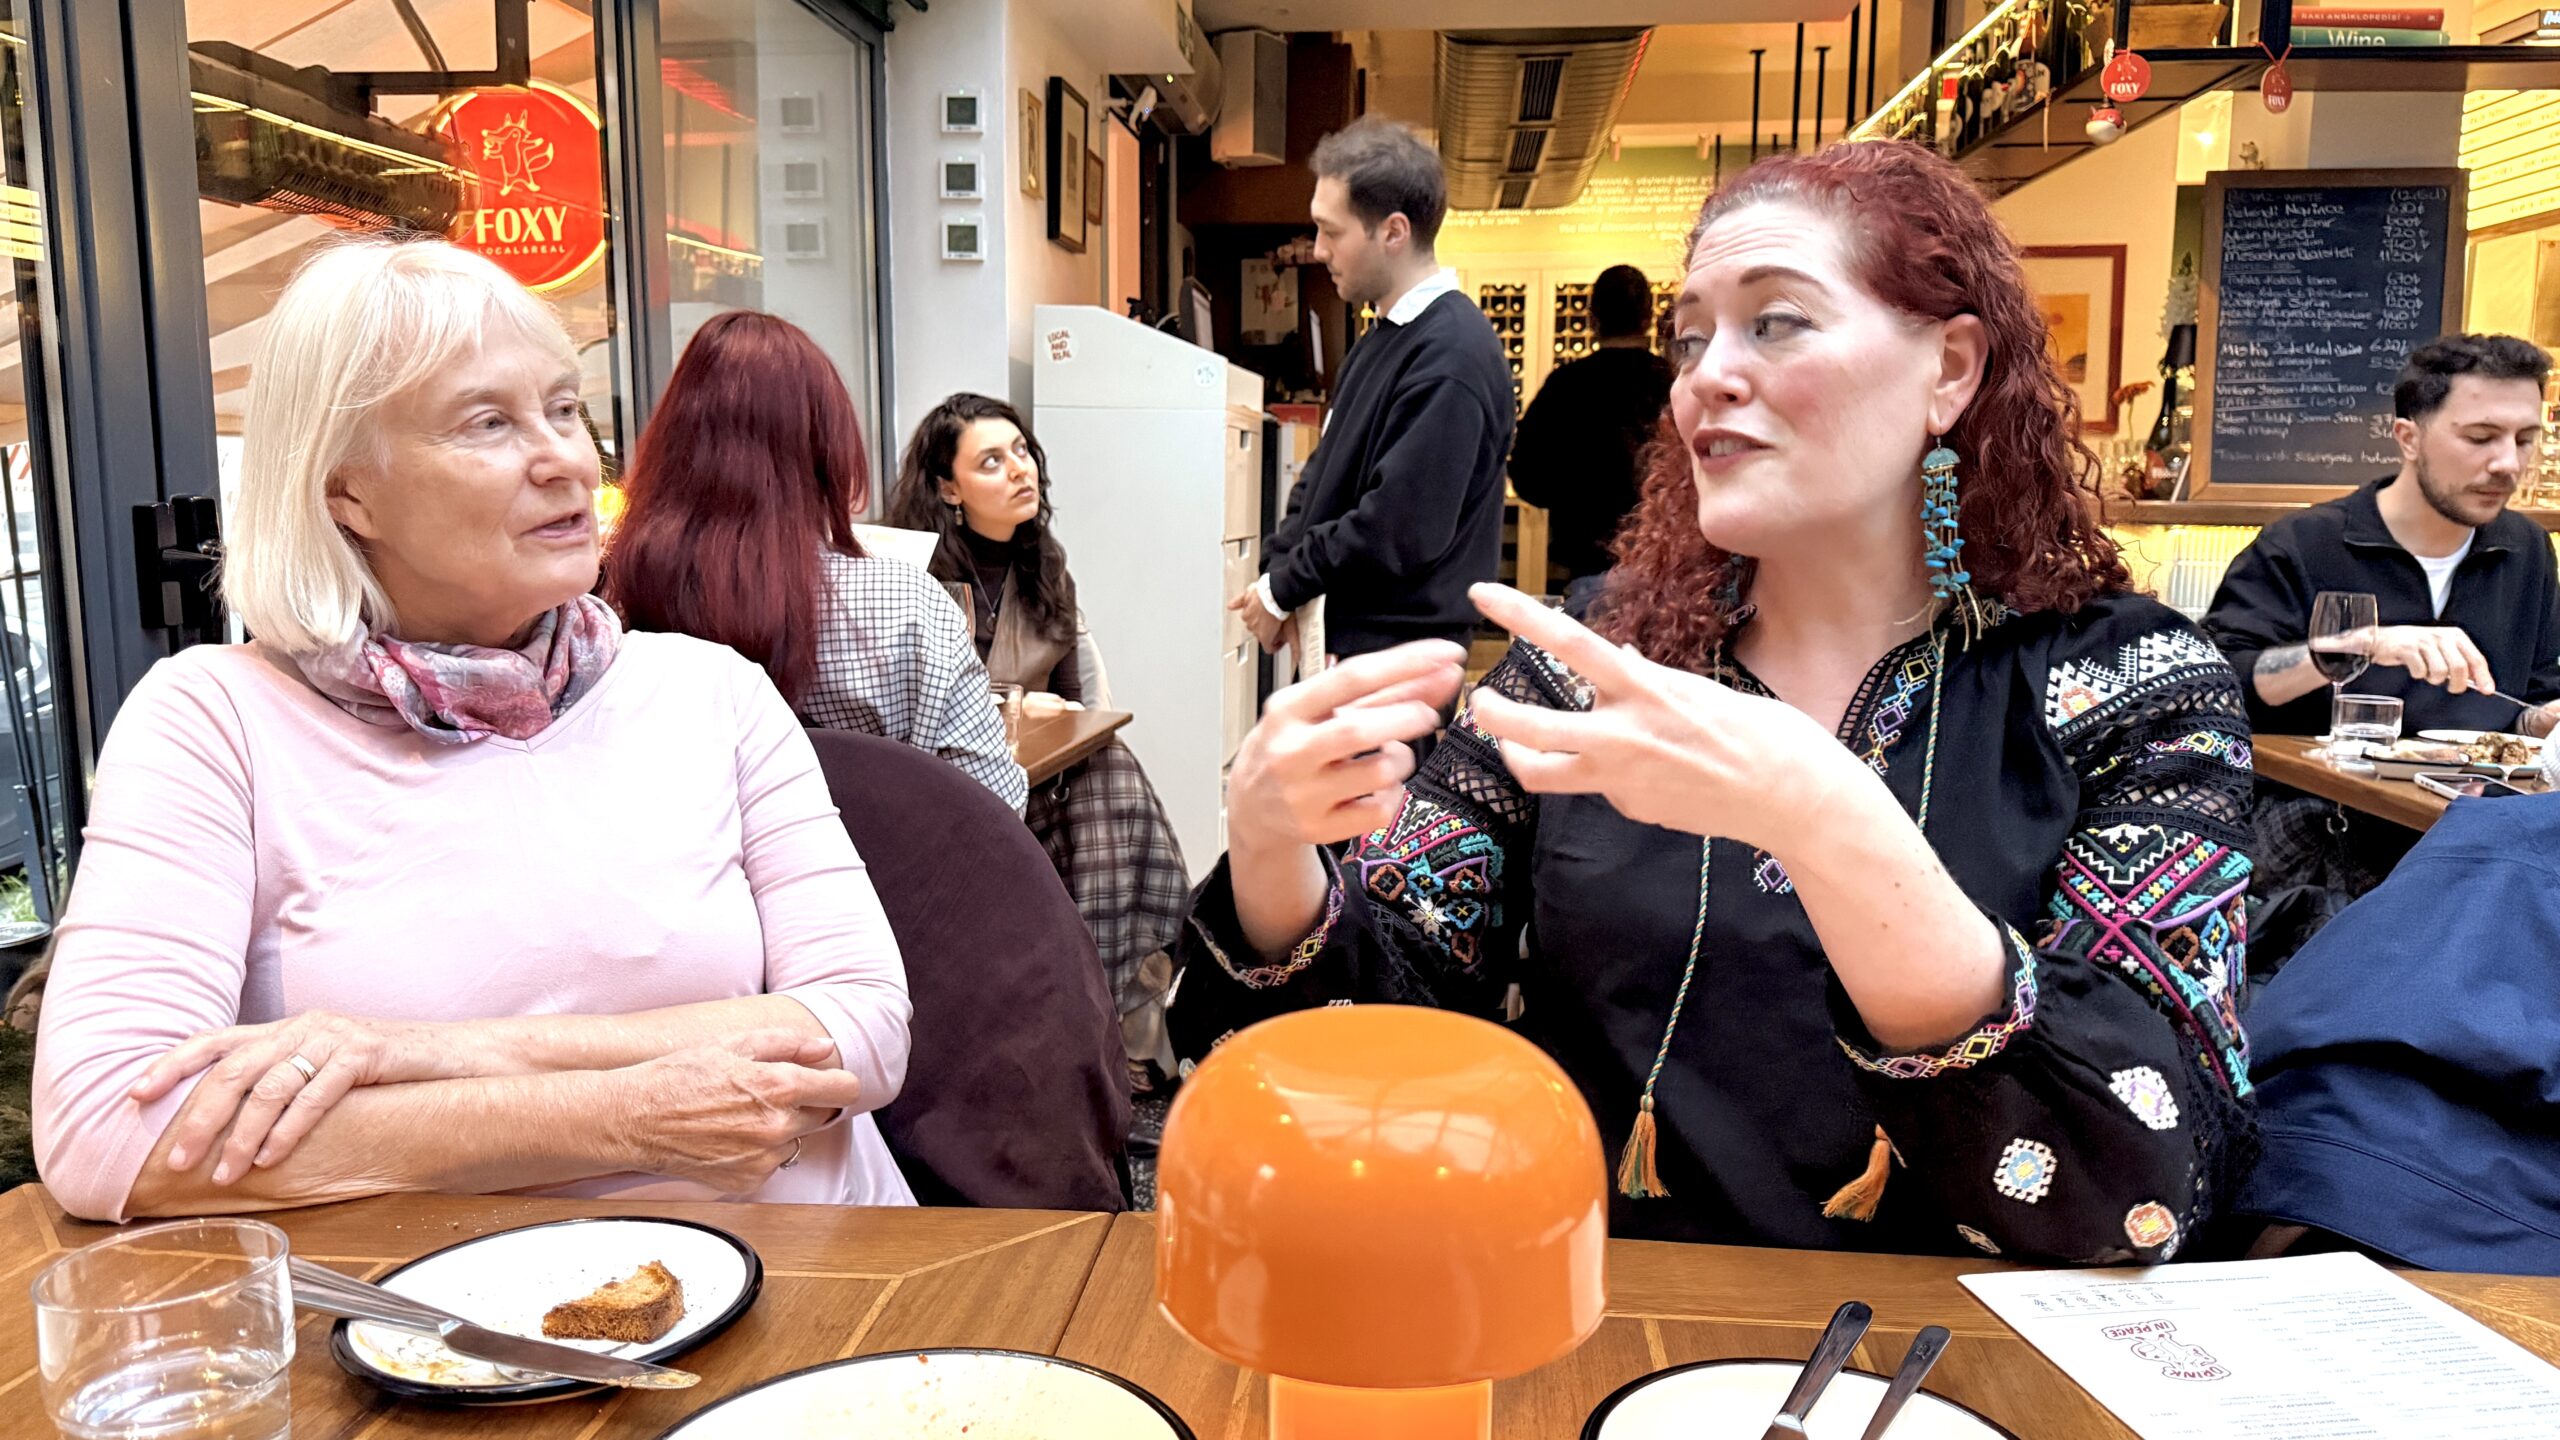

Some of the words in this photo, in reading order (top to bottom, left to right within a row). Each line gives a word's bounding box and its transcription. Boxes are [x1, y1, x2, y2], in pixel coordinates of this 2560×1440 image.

[2327, 29, 2386, 46] Wine
[2110, 82, 2141, 94] FOXY
[2267, 94, 2286, 107] FOXY
[475, 206, 567, 244] FOXY
[1048, 330, 1070, 343] LOCAL
[1051, 340, 1068, 351] AND
[1053, 350, 1071, 361] REAL
[2109, 1326, 2153, 1338] PEACE
[2154, 1321, 2170, 1331] IN
[2170, 1366, 2223, 1379] DRINK
